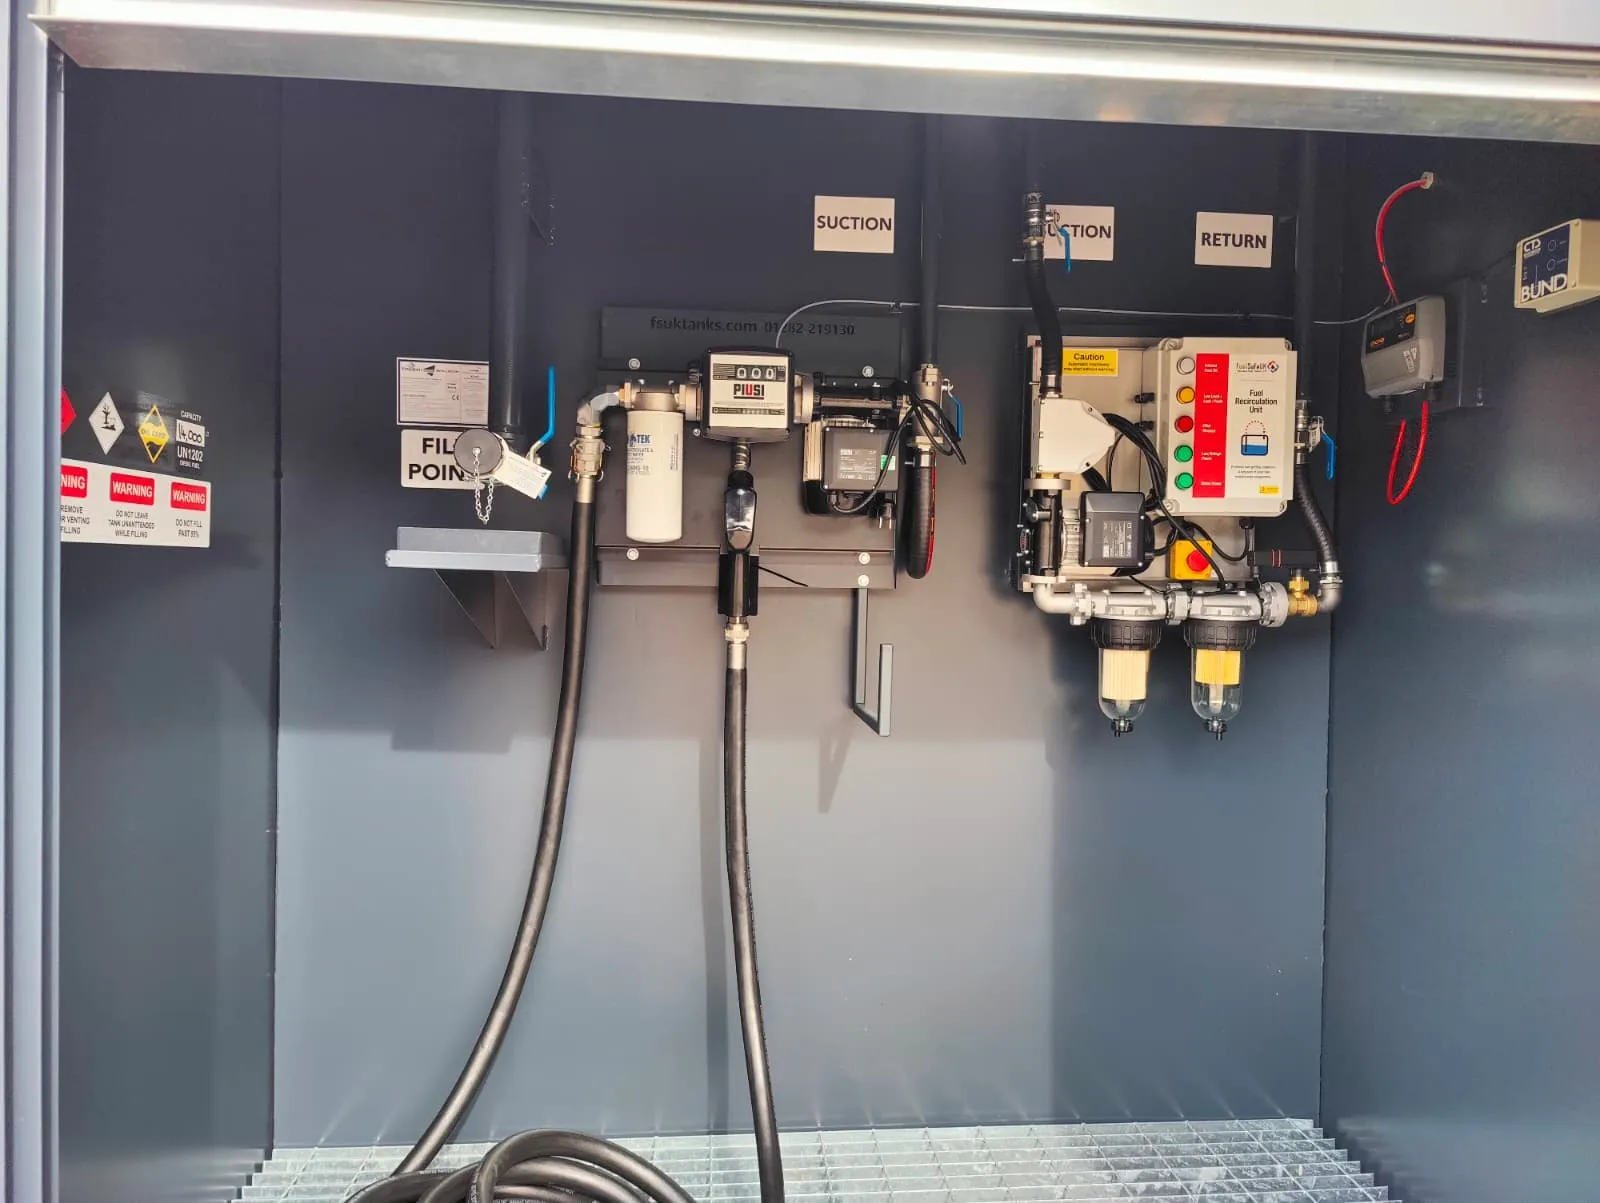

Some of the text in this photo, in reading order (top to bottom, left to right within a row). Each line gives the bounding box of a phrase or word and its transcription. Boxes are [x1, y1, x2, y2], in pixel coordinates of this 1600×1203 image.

[817, 215, 892, 231] SUCTION
[1047, 223, 1112, 239] UTION
[1201, 232, 1267, 249] RETURN
[1521, 273, 1568, 302] BUND
[650, 315, 758, 333] fsuktanks.com
[808, 322, 856, 336] 219130
[1073, 353, 1105, 361] Caution
[733, 384, 765, 396] PIUSI
[1249, 389, 1264, 397] Fuel
[1234, 397, 1278, 405] Recirculation
[181, 410, 202, 421] CAPACITY
[422, 437, 454, 455] FIL
[637, 434, 651, 444] TEK
[177, 446, 204, 462] UN1202
[408, 464, 465, 482] POIN
[61, 474, 86, 490] NING
[112, 480, 153, 498] WARNING
[173, 489, 206, 505] WARNING
[60, 504, 84, 514] REMOVE
[134, 511, 149, 519] LEAVE
[66, 516, 91, 525] VENTING
[175, 518, 183, 527] DO
